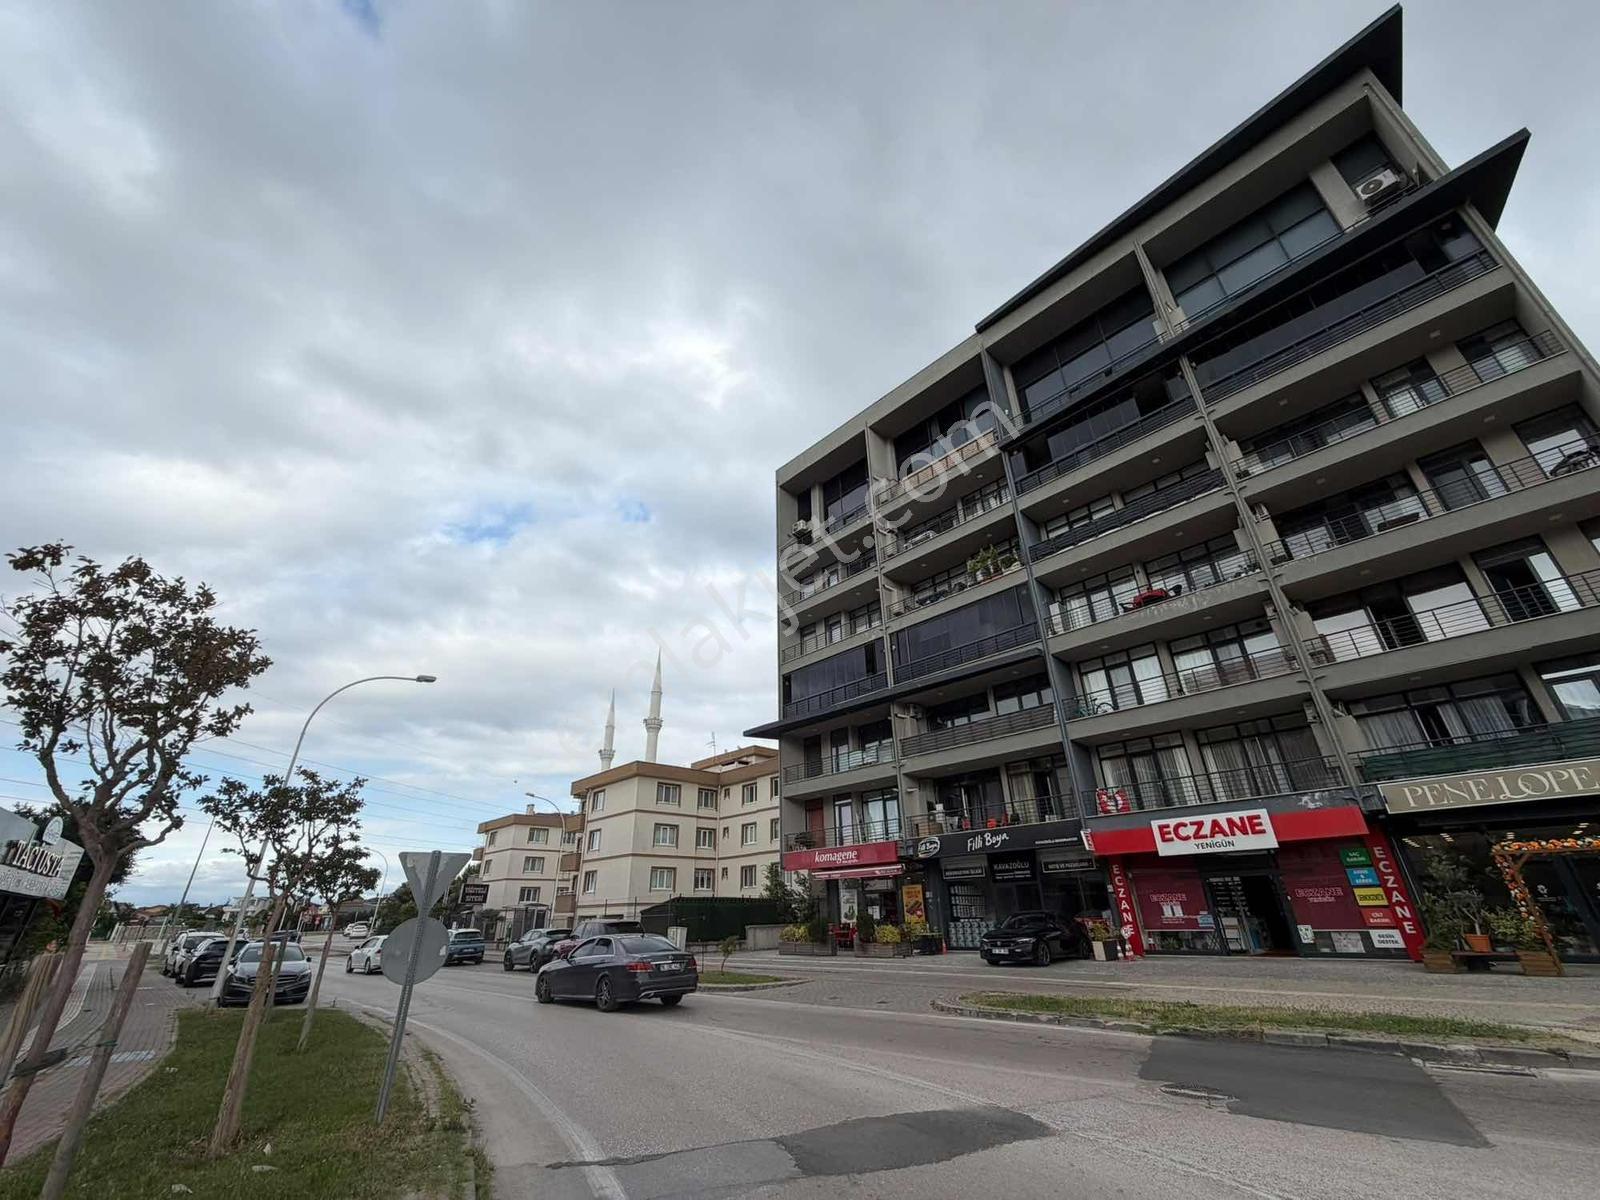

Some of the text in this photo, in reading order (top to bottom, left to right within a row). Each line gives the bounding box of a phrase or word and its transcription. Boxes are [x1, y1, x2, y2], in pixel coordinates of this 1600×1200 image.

[1402, 766, 1600, 808] PENELOPE
[967, 832, 1010, 852] Filli Boya
[1157, 814, 1267, 843] ECZANE
[814, 849, 858, 864] komagene
[1194, 839, 1235, 850] YENİGÜN
[1113, 864, 1134, 936] ECZANE
[1373, 846, 1416, 934] ECZANE
